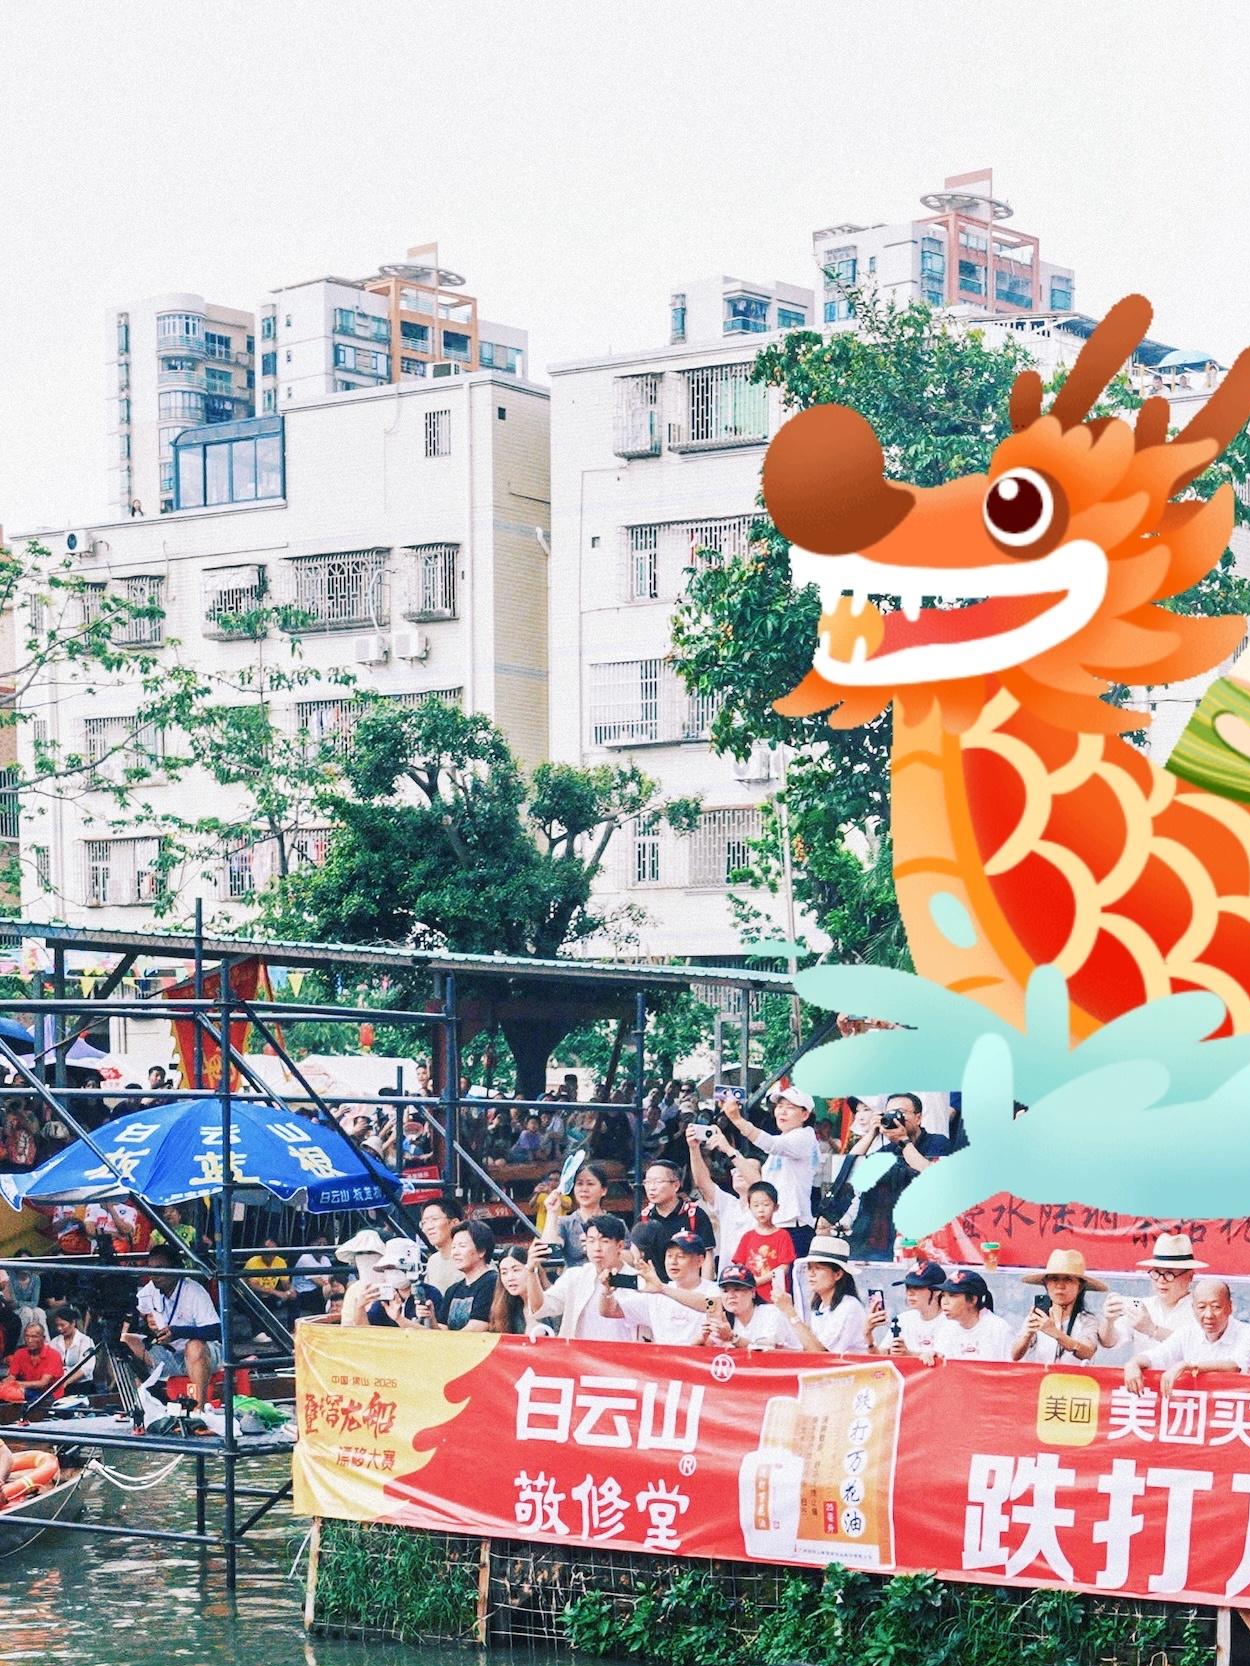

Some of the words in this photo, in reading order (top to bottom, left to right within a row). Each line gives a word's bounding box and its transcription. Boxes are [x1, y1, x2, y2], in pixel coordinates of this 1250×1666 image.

[113, 1122, 312, 1145] 白云山
[320, 1189, 350, 1204] 白云山
[514, 1366, 706, 1453] 白云山
[1044, 1395, 1092, 1424] 美团
[842, 1392, 872, 1533] 跌打万花油
[514, 1470, 690, 1550] 敬修堂
